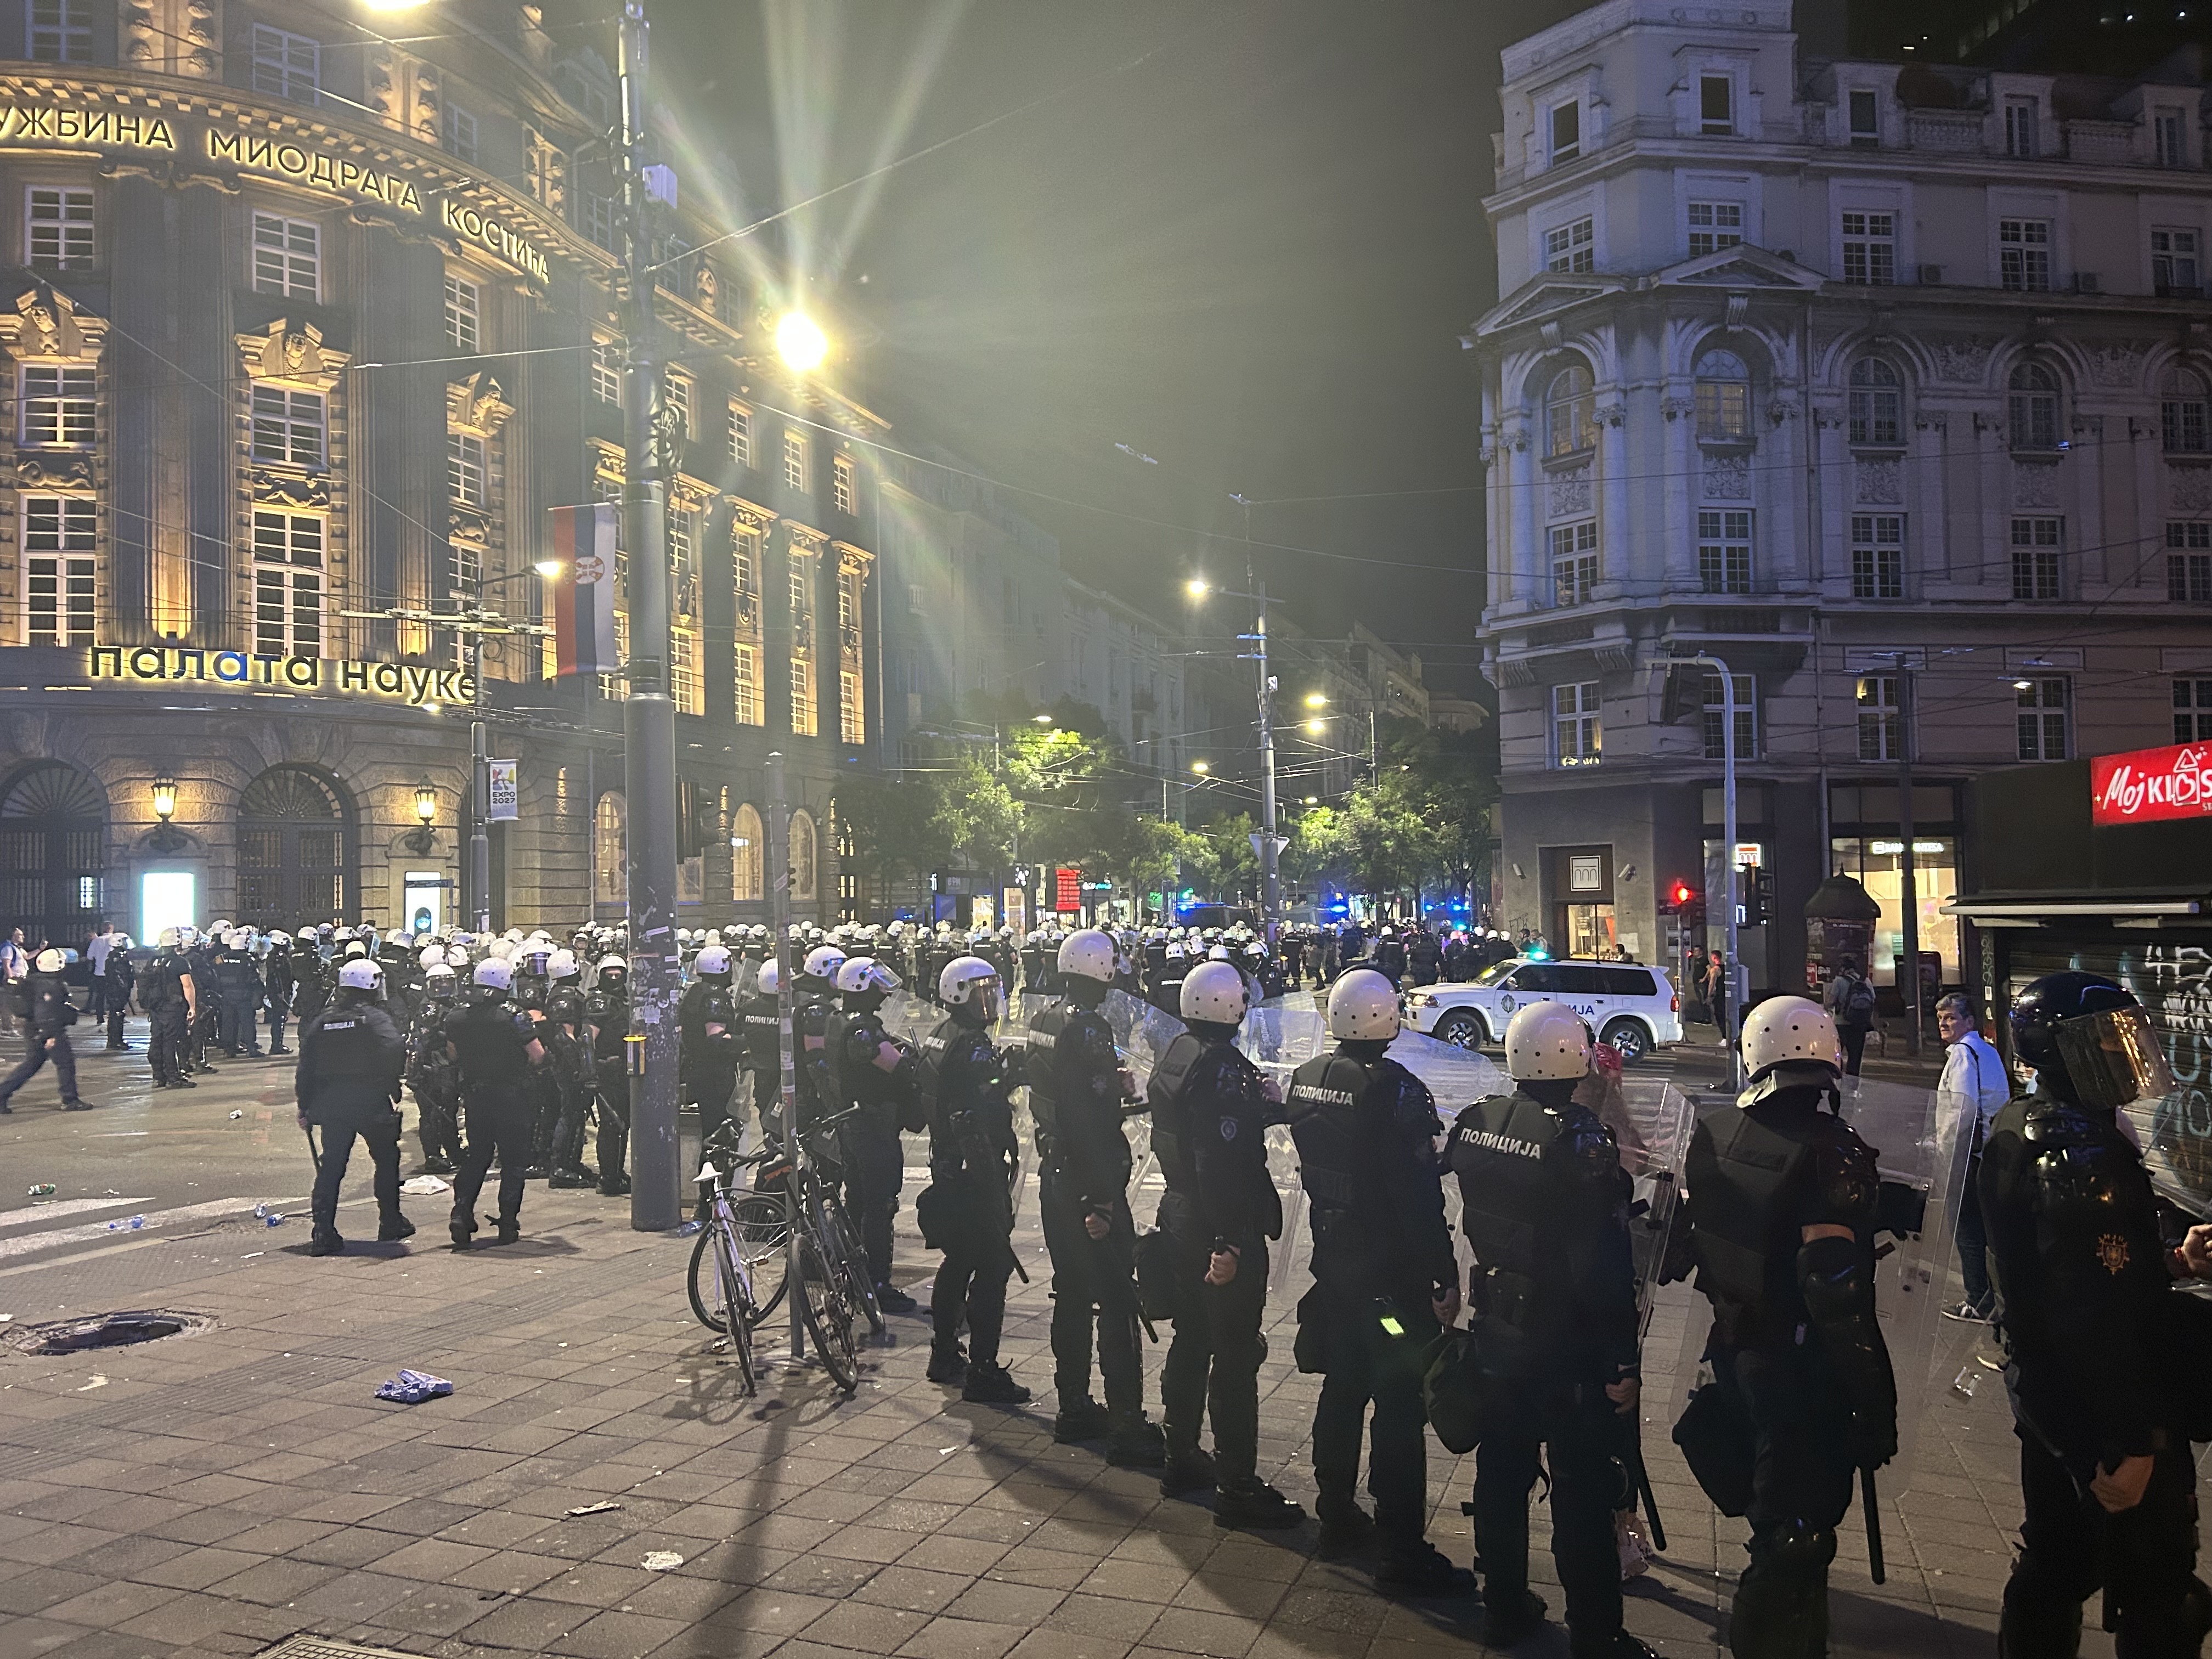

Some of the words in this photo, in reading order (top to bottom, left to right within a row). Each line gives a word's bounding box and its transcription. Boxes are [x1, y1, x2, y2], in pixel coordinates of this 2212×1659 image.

[210, 128, 422, 213] МИОДРАГА
[91, 646, 318, 686] палата
[341, 660, 475, 705] науке
[2102, 765, 2145, 814] Moj
[745, 1015, 779, 1025] ПОЛИЦИЈ
[1292, 1084, 1353, 1106] ПОЛИЦИЈА
[1460, 1127, 1541, 1160] ПОЛИЦИЈА
